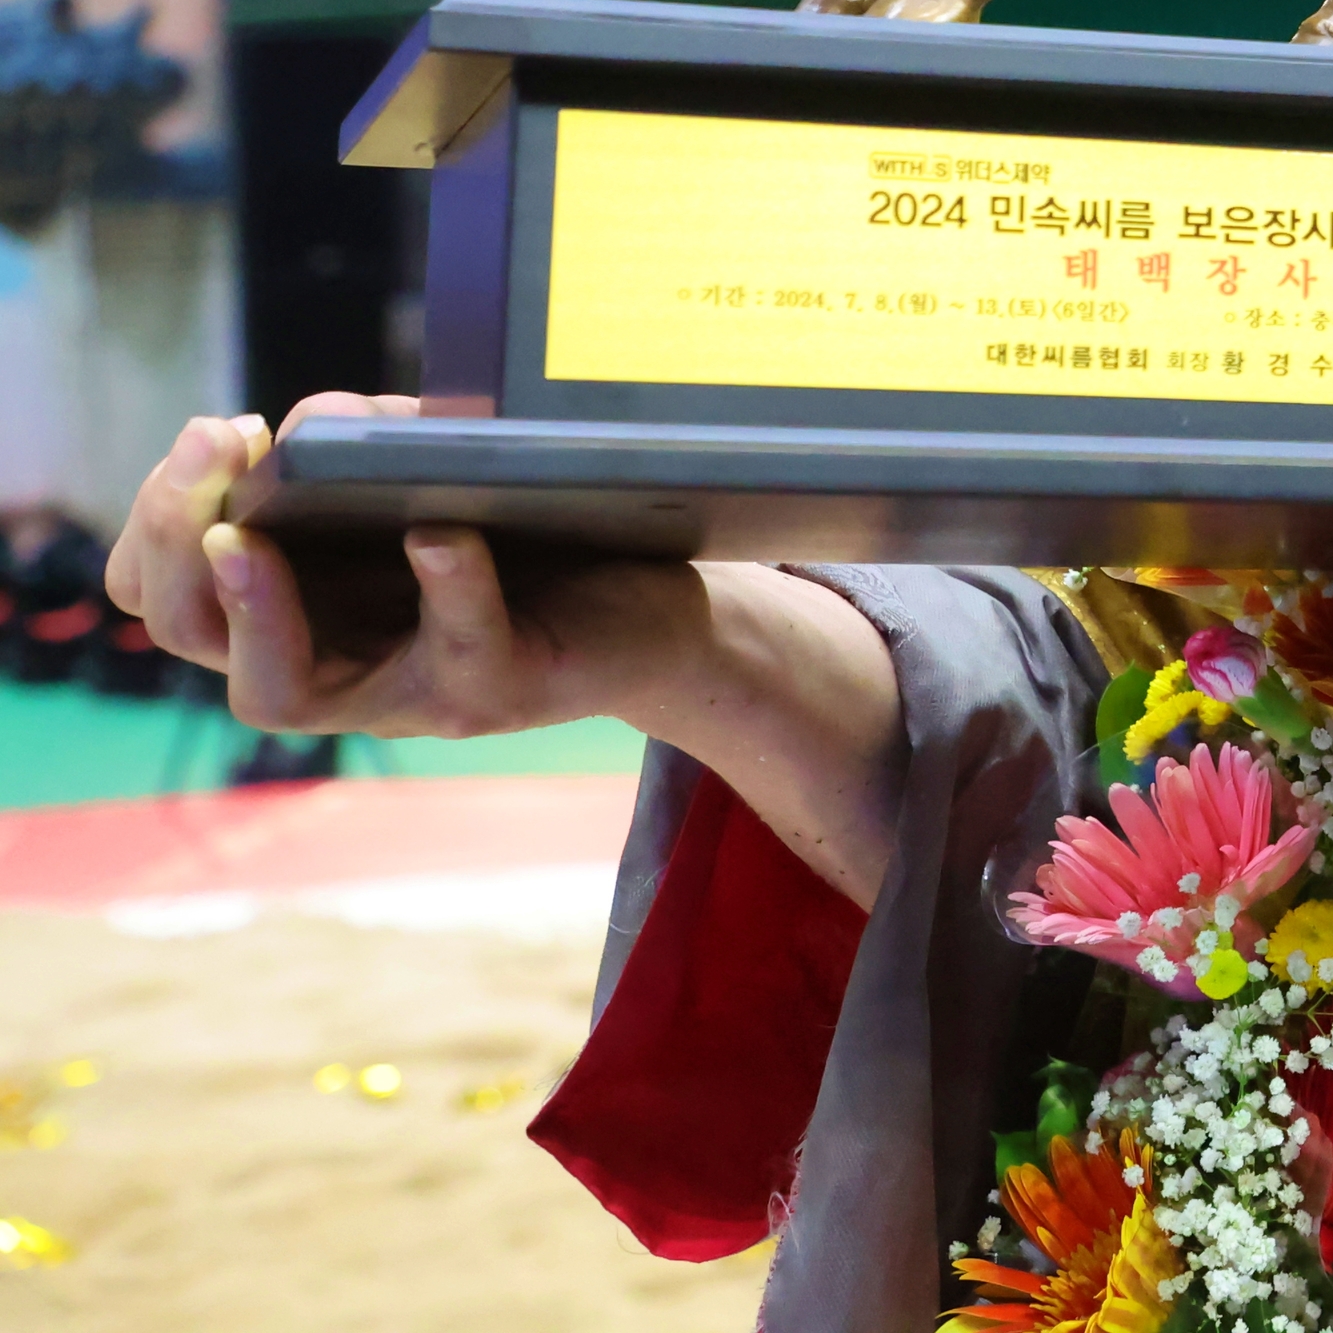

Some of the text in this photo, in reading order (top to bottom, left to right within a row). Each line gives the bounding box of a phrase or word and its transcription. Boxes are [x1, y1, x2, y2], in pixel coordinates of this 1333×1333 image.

[955, 159, 1051, 185] 위더스제약
[869, 191, 967, 228] 2024
[990, 195, 1155, 241] 민속씨름
[701, 284, 747, 308] 기간
[1244, 307, 1285, 329] 장소
[986, 343, 1148, 371] 대한씨름협회
[1166, 351, 1210, 372] 회장
